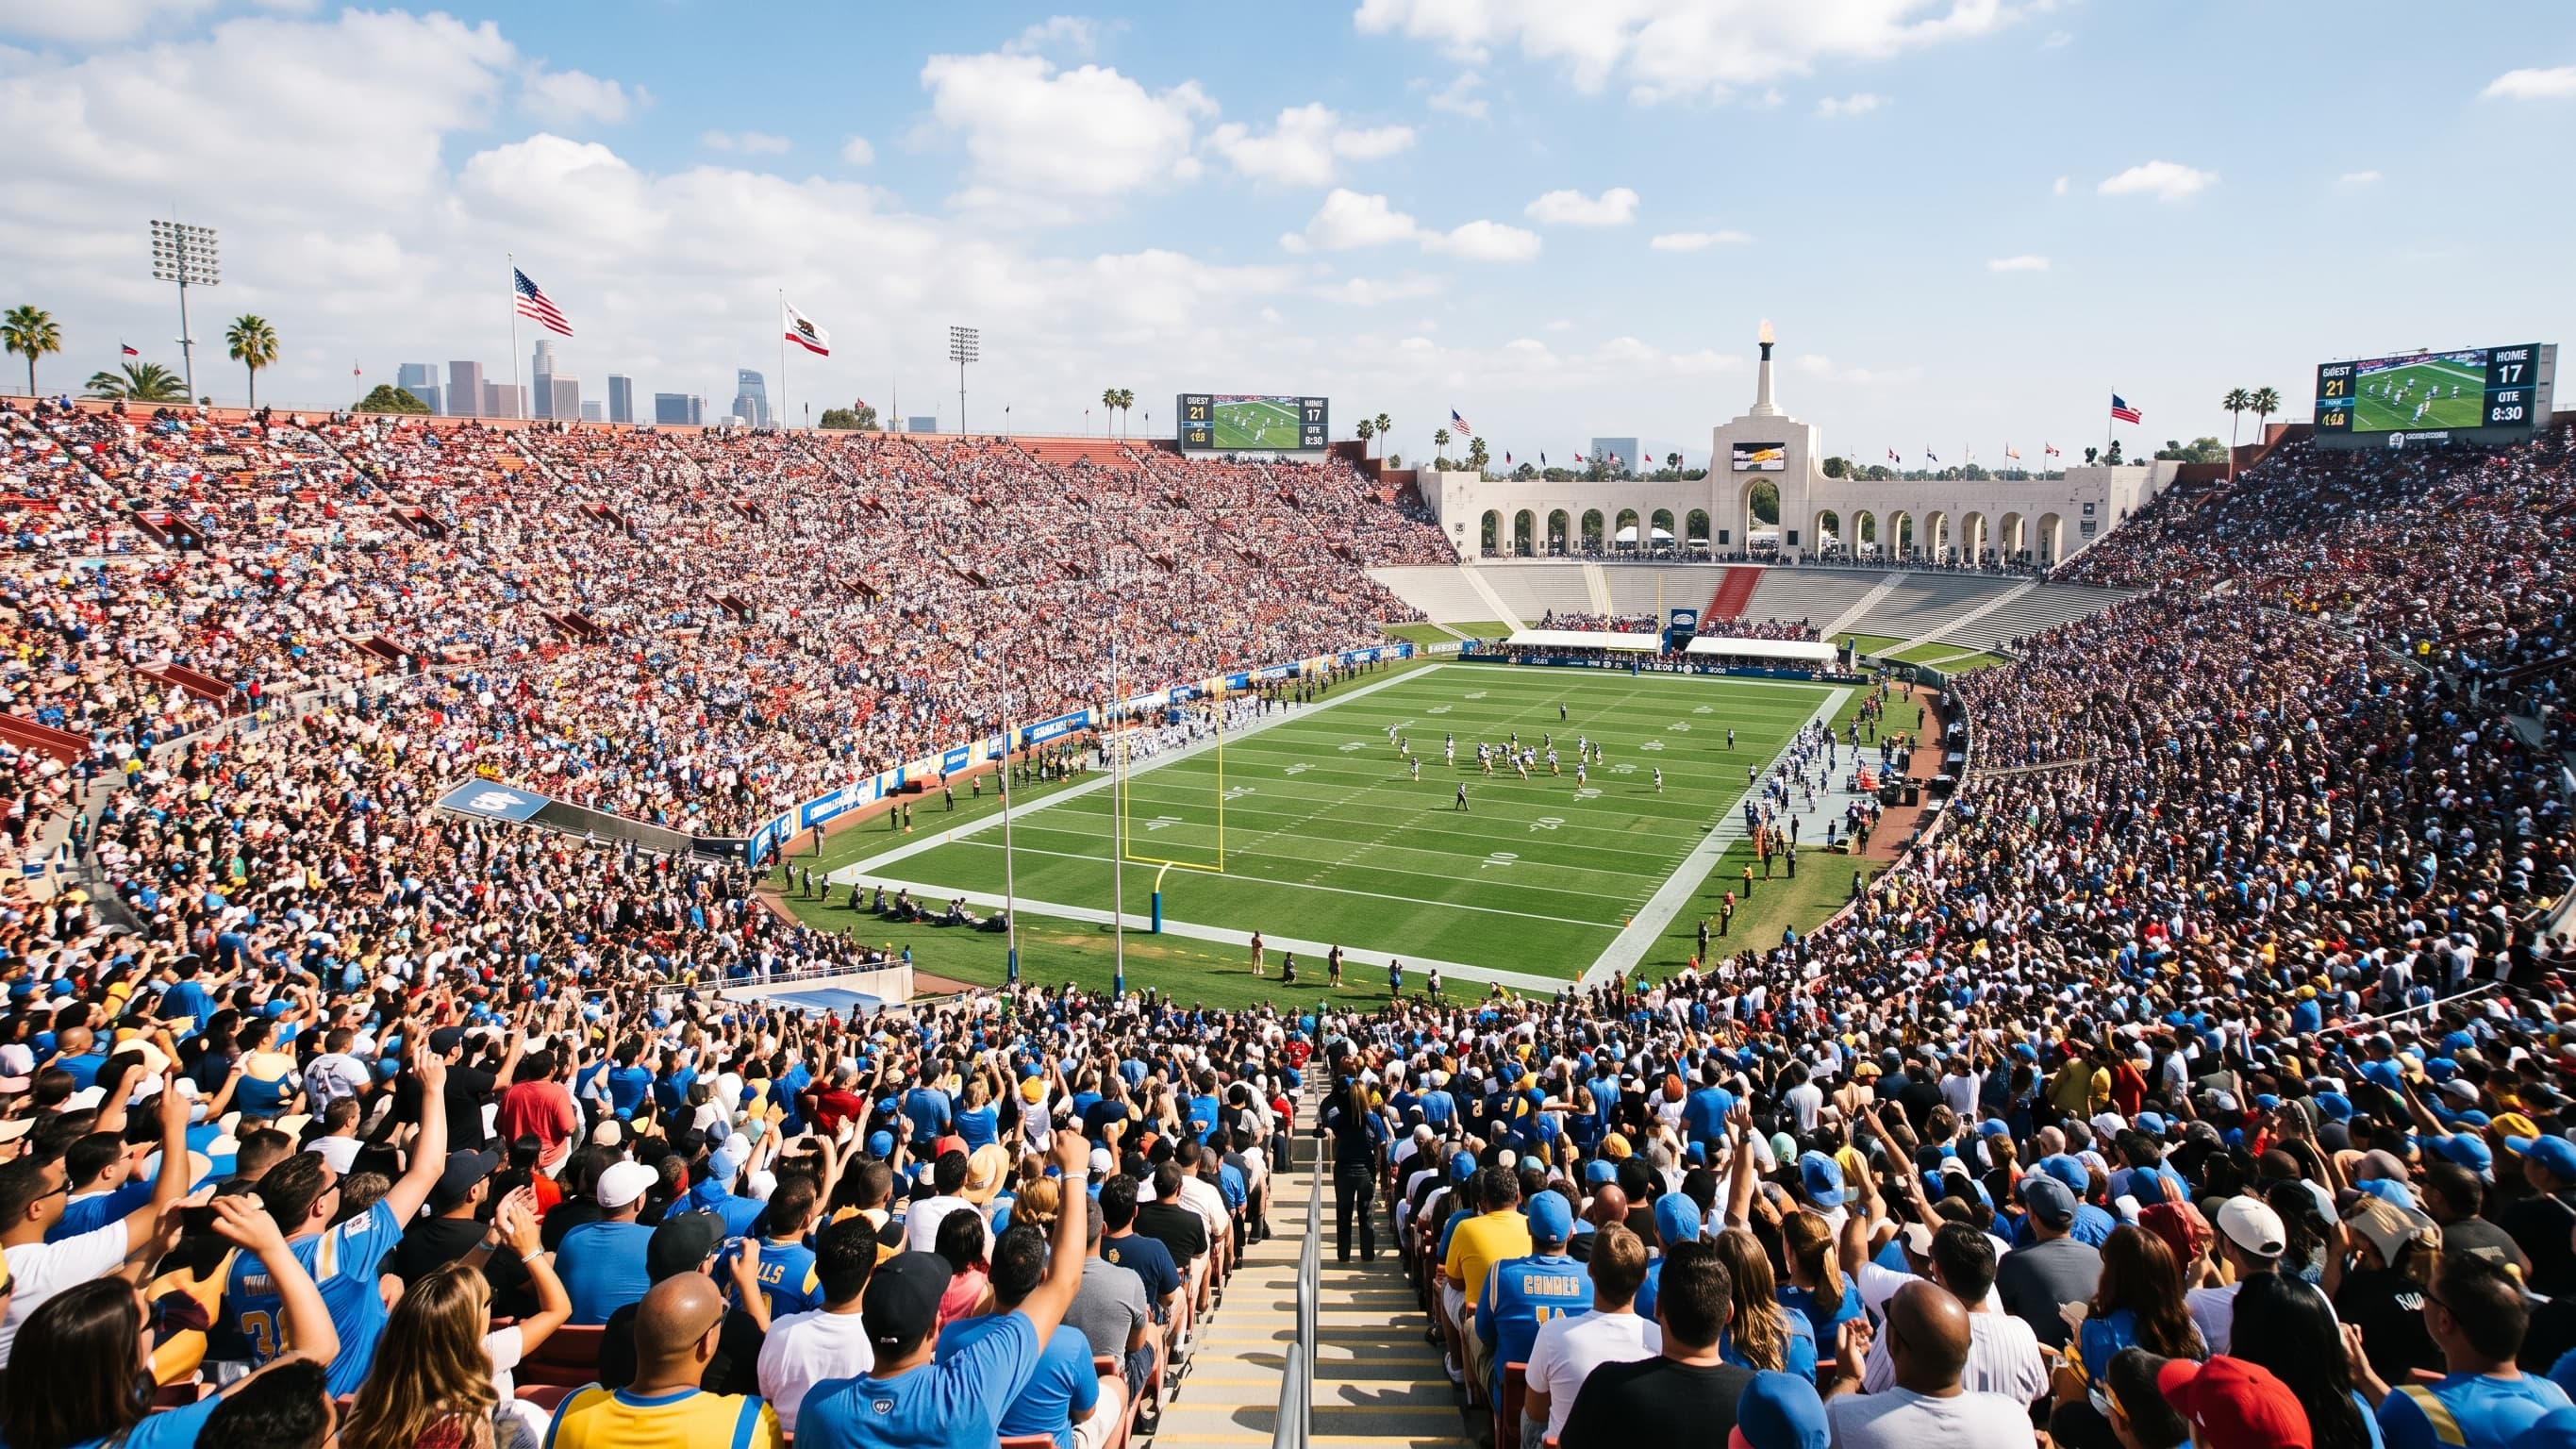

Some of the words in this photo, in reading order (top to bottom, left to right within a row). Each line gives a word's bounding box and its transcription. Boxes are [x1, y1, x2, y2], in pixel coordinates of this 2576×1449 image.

[2496, 349, 2528, 362] HOME
[2499, 364, 2523, 383] 17
[2325, 379, 2344, 396] 21
[1189, 407, 1205, 419] 21
[1306, 408, 1321, 422] 17
[2491, 406, 2523, 421] 8:30
[1305, 436, 1323, 445] 8:30
[1531, 817, 1566, 830] 20
[1483, 852, 1519, 866] 10
